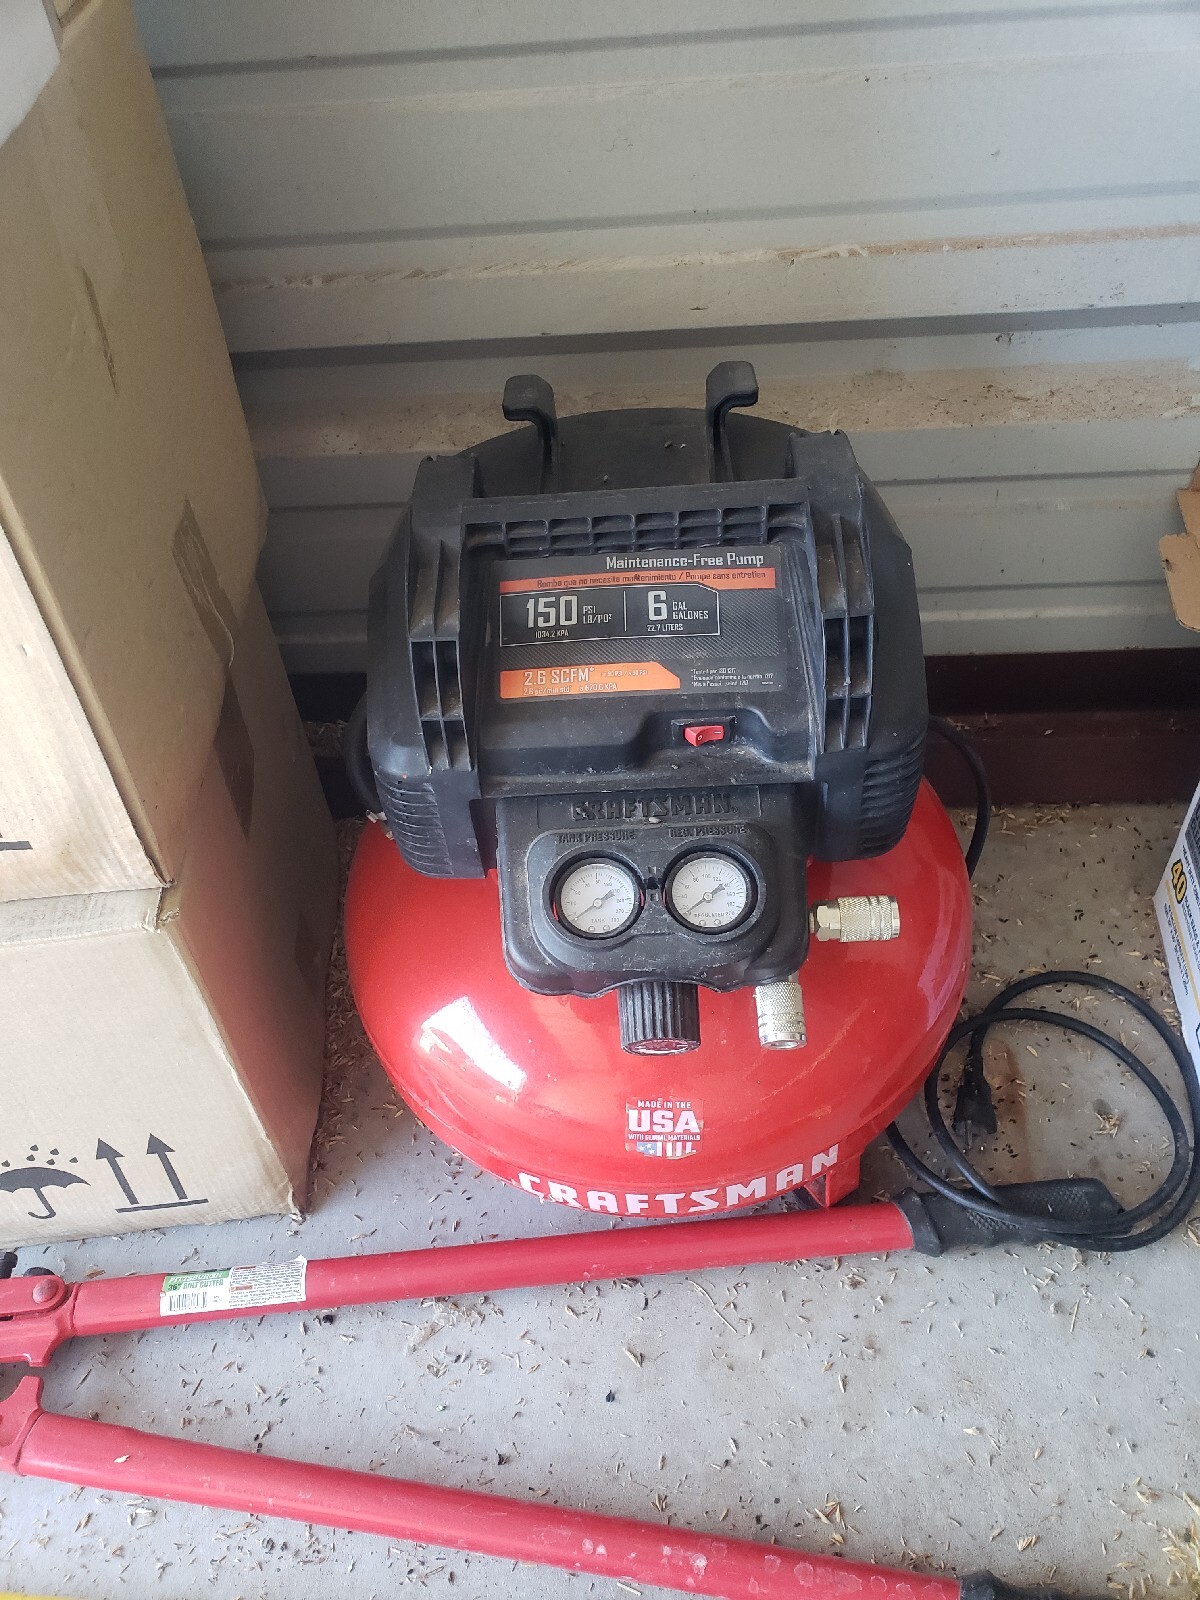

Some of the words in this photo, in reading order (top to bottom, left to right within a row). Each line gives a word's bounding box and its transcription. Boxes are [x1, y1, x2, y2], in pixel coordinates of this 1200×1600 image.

[606, 553, 723, 569] Maintenance-Free
[726, 552, 764, 567] Pump
[712, 572, 730, 580] sans
[731, 570, 766, 580] entretien
[526, 595, 578, 628] 150
[583, 605, 596, 615] PSI
[647, 590, 668, 621] 6
[672, 601, 688, 611] GAL
[672, 610, 709, 621] GALONES
[661, 622, 684, 632] LITERS
[556, 629, 569, 638] KPA
[523, 670, 546, 686] 2.6
[556, 833, 581, 843] TANK
[583, 830, 635, 843] PRESSURE
[695, 825, 747, 837] PRESSURE
[1171, 858, 1187, 904] 40
[638, 1100, 662, 1108] MADE
[628, 1109, 701, 1133] USA
[517, 1143, 840, 1214] CRAFTSMAN
